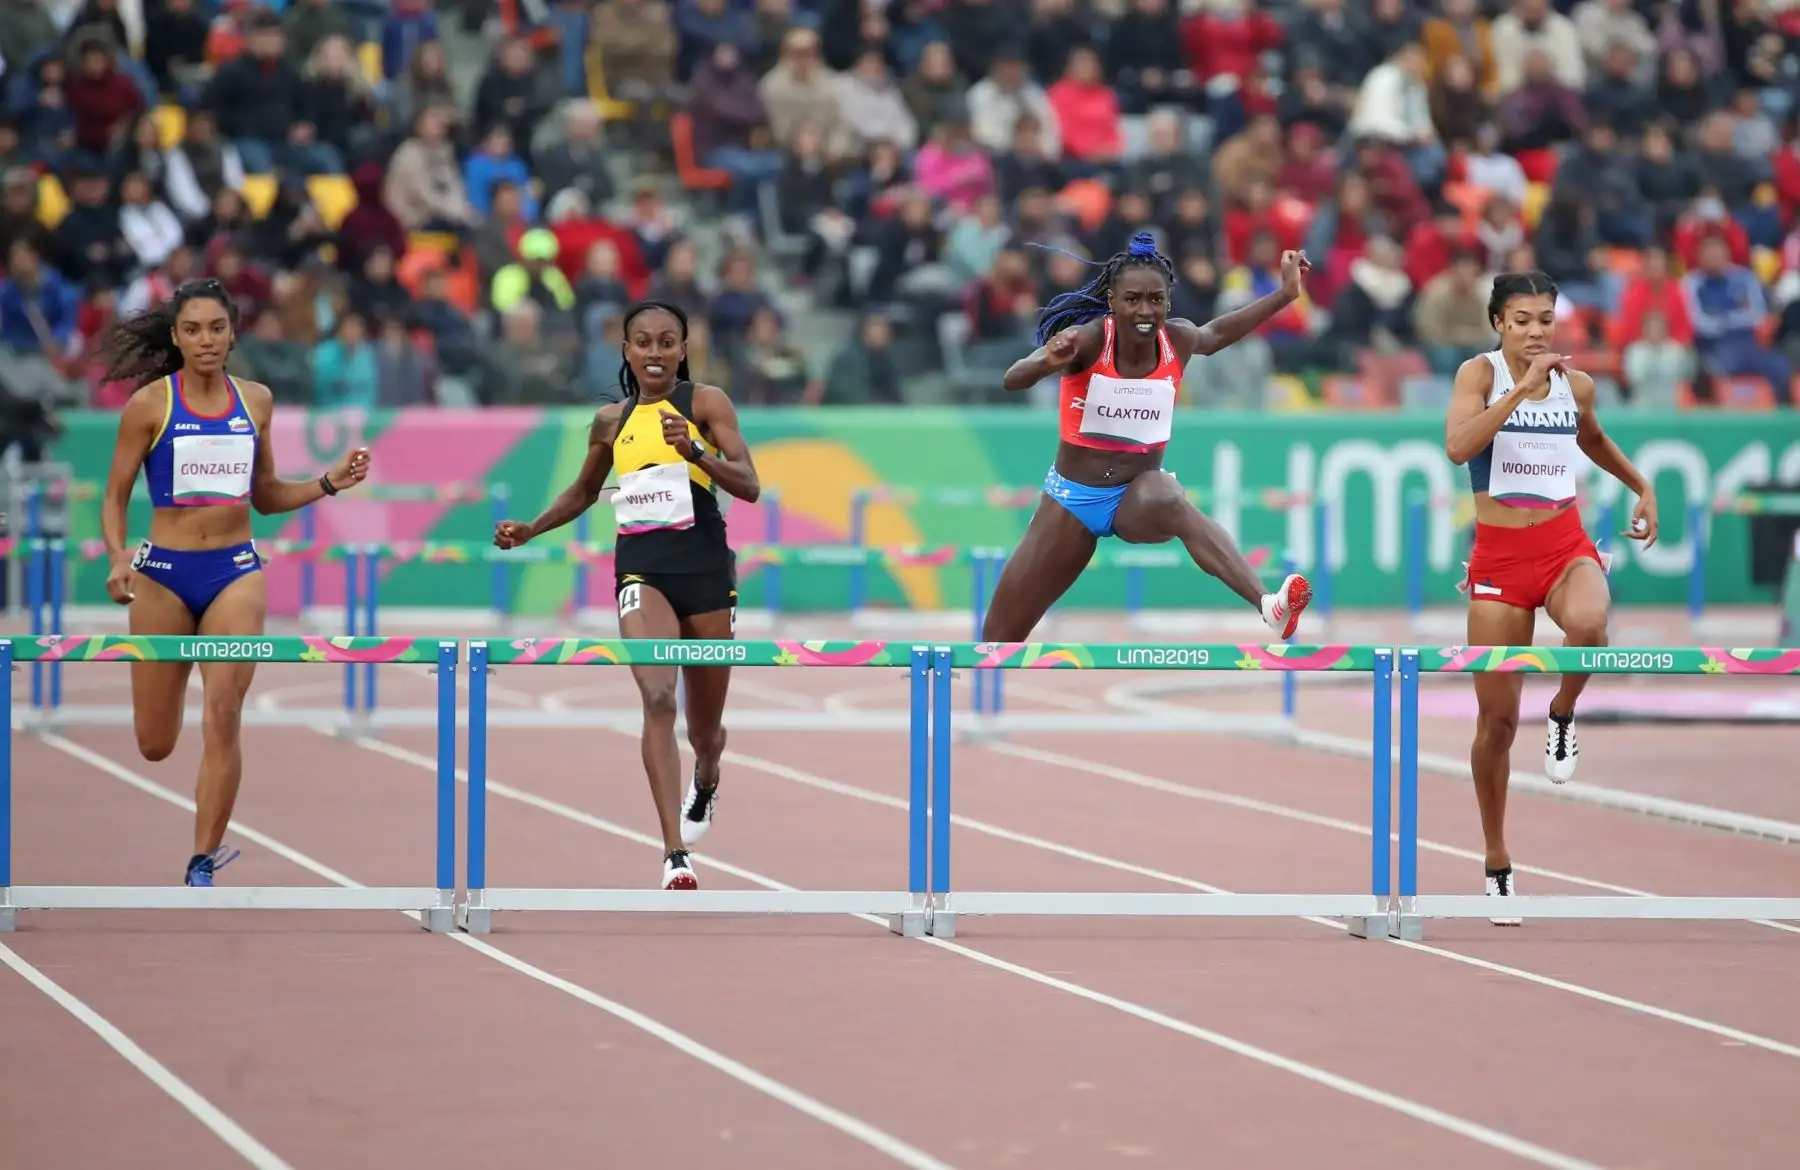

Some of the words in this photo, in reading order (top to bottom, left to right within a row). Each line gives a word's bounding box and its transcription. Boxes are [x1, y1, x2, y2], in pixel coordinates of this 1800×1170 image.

[1097, 405, 1160, 420] CLAXTON
[1503, 410, 1577, 428] ANAMA
[174, 423, 200, 431] SAETA
[181, 462, 248, 475] GONZALEZ
[1502, 461, 1567, 476] WOODRUFF
[625, 490, 674, 505] WHYTE
[145, 560, 172, 570] SAETA
[622, 587, 638, 608] 4
